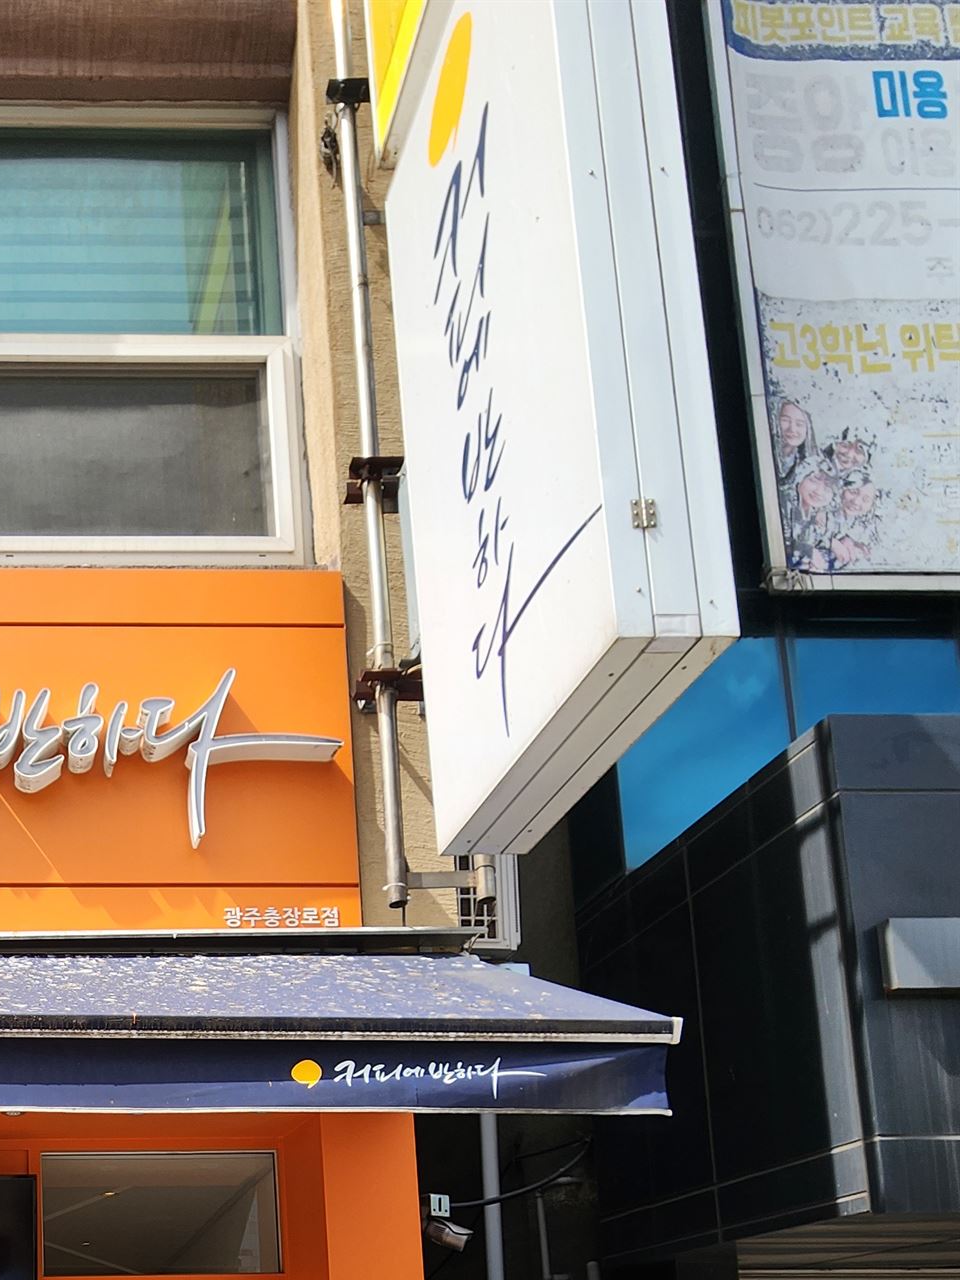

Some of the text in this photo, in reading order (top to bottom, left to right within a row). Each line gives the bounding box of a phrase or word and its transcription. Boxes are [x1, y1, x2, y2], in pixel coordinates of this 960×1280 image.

[872, 69, 948, 119] 미용
[769, 321, 891, 374] 고3학년
[223, 906, 340, 928] 광주충장로점
